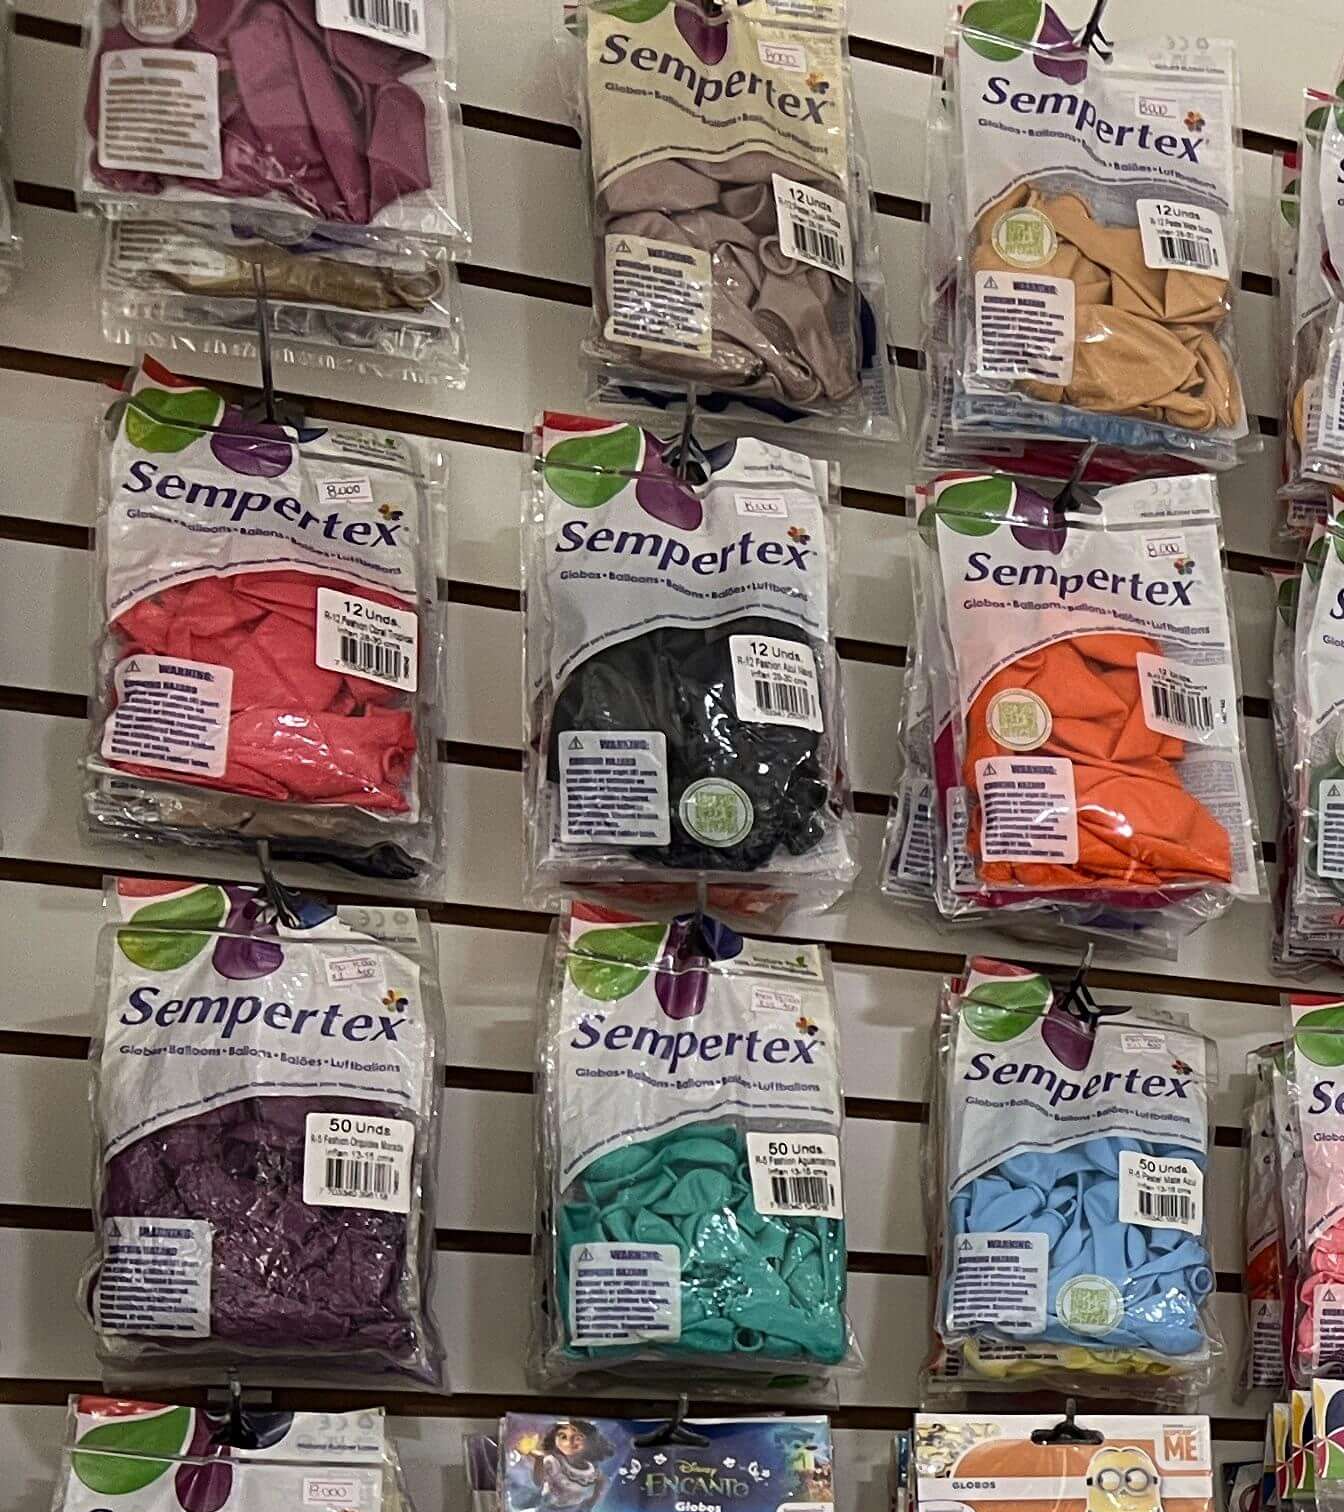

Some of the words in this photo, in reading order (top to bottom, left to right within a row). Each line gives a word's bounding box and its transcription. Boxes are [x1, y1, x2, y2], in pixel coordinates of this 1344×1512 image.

[600, 34, 827, 125] Sempertex
[981, 76, 1204, 164] Sempertex
[1155, 203, 1171, 217] 12
[121, 459, 400, 549] Sempertex
[555, 519, 815, 576] Sempertex
[560, 569, 602, 581] Globos
[963, 550, 1195, 609] Sempertex
[343, 600, 364, 617] 12
[963, 598, 1006, 612] Globos
[749, 641, 768, 657] 12
[119, 985, 408, 1044] Sempertex
[570, 1015, 822, 1076] Sempertex
[963, 1053, 1193, 1103] Sempertex
[329, 1117, 353, 1135] 50
[768, 1142, 789, 1158] 50
[1138, 1156, 1157, 1173] 50
[1163, 1434, 1197, 1463] ME
[643, 1472, 750, 1499] ENCANTO
[951, 1480, 996, 1491] GLOBOS
